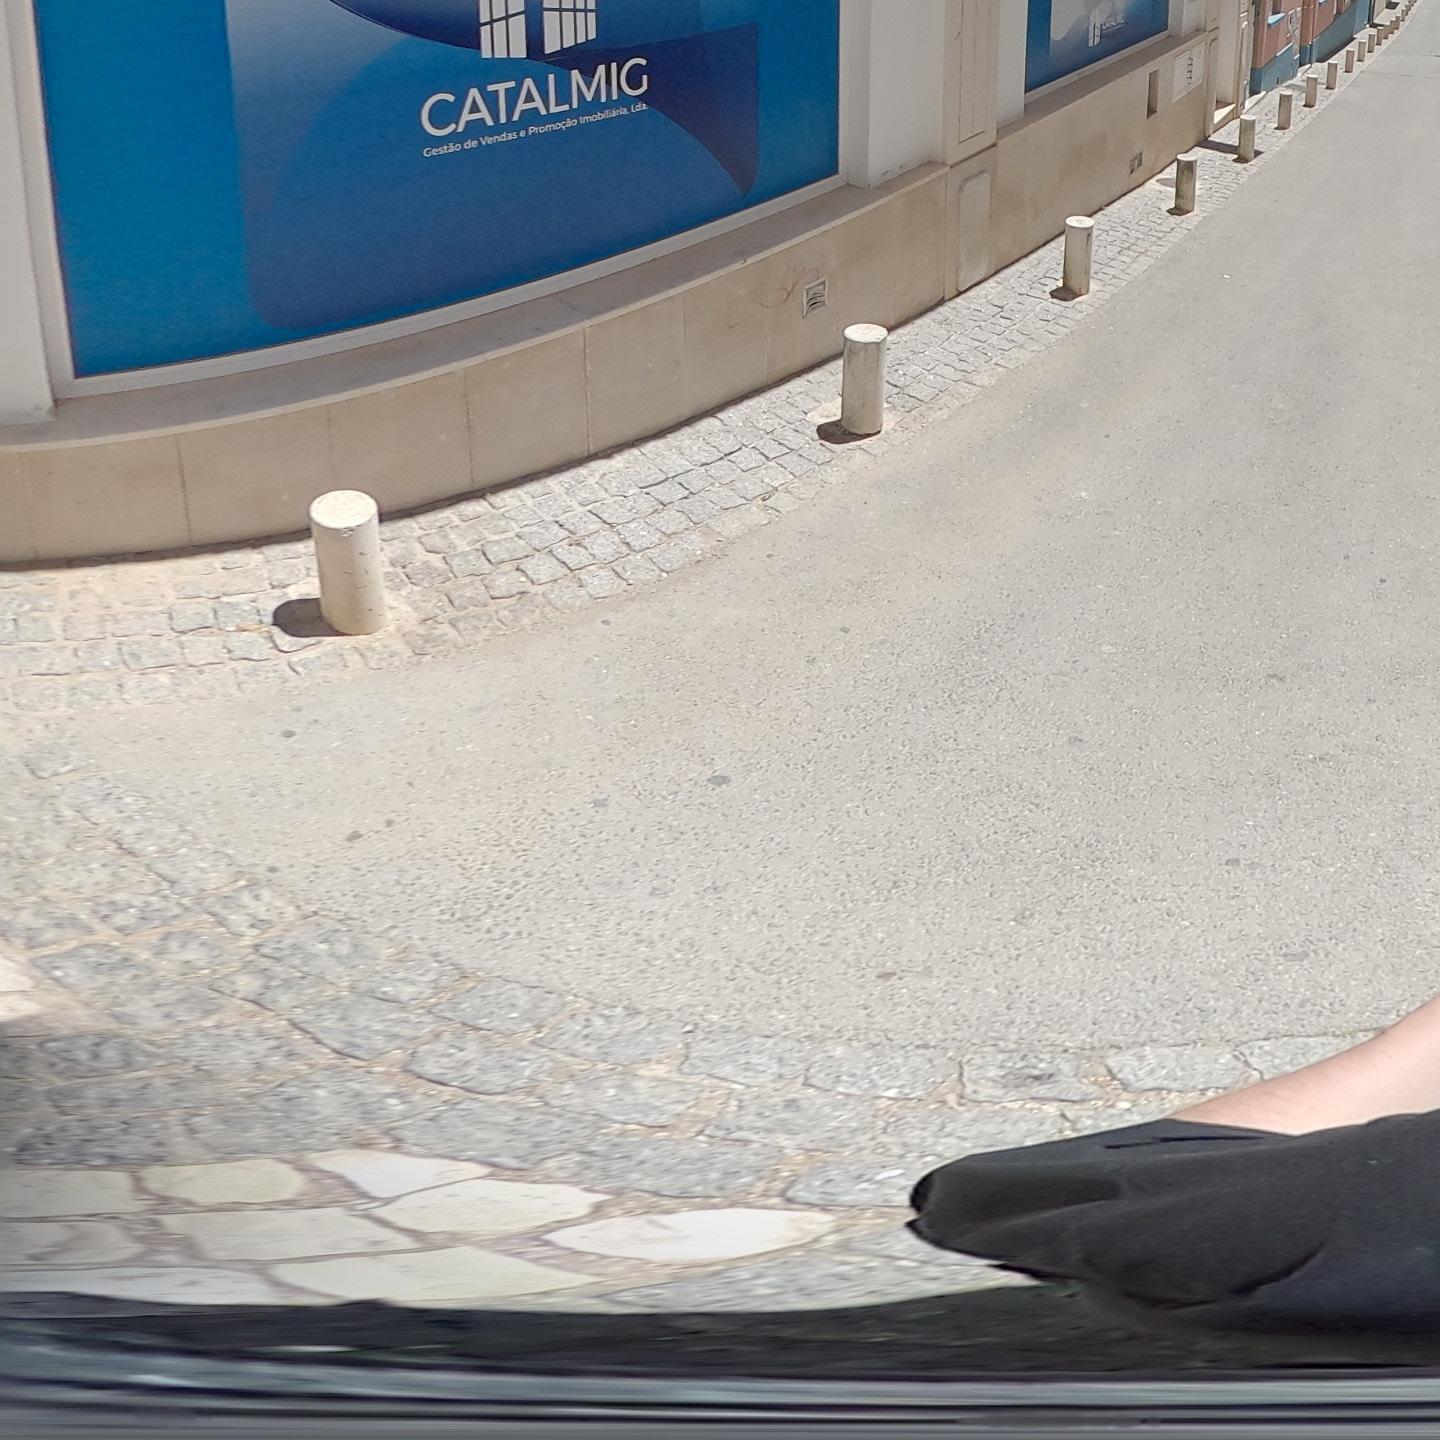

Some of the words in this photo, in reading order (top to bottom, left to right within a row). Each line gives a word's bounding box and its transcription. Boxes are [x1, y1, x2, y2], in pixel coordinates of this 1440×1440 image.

[420, 57, 648, 137] CATALMIG
[423, 141, 461, 157] Gestão
[464, 138, 478, 149] de
[480, 130, 518, 146] Vendas
[519, 130, 526, 138] e
[528, 117, 578, 136] Promoção
